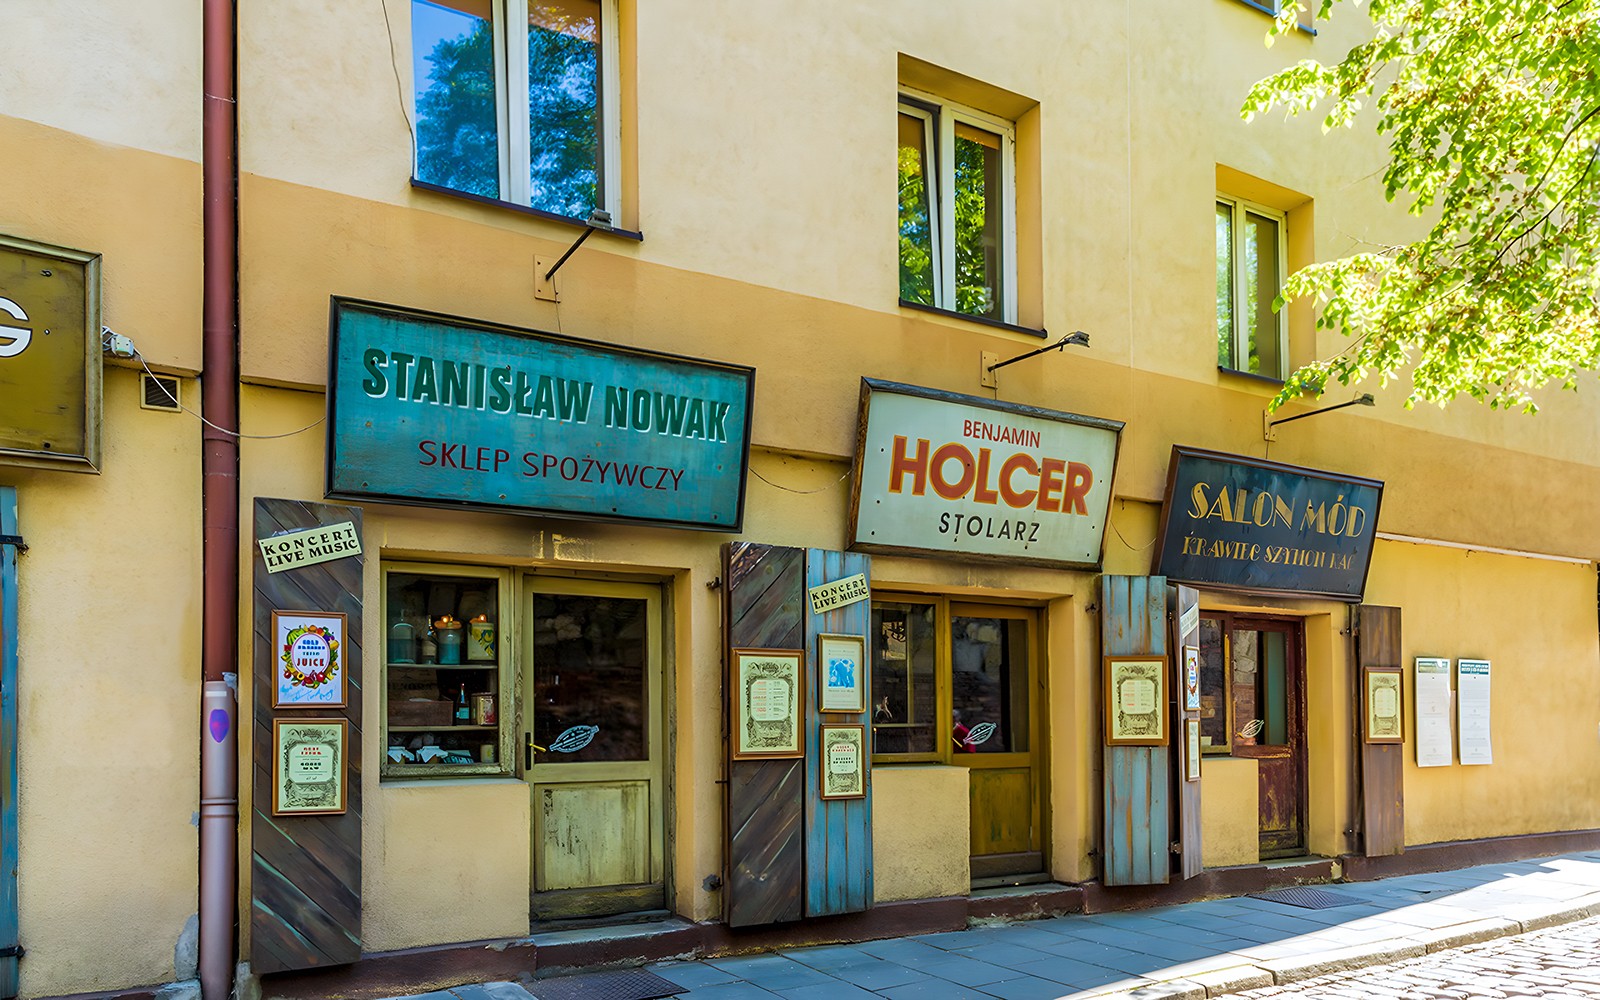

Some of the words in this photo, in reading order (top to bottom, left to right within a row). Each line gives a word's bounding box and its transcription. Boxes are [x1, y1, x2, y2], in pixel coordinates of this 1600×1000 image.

[362, 348, 594, 424] STANISŁAW
[605, 385, 730, 443] NOWAK
[963, 419, 1041, 448] BENJAMIN
[418, 440, 510, 473] SKLEP
[522, 452, 685, 491] SPOŻYWCZY
[888, 434, 1093, 516] HOLCER
[1187, 482, 1295, 530] SALON
[1300, 494, 1366, 537] MÓD
[939, 512, 1040, 542] STOLARZ
[263, 528, 353, 555] KONCERT
[267, 551, 304, 567] LIVE
[309, 540, 357, 558] MUSIC
[1181, 536, 1260, 562] KRAWIEC
[812, 578, 864, 601] KONCERT
[814, 596, 837, 609] LIVE
[839, 587, 867, 602] MUSIC
[297, 658, 324, 667] JUICE
